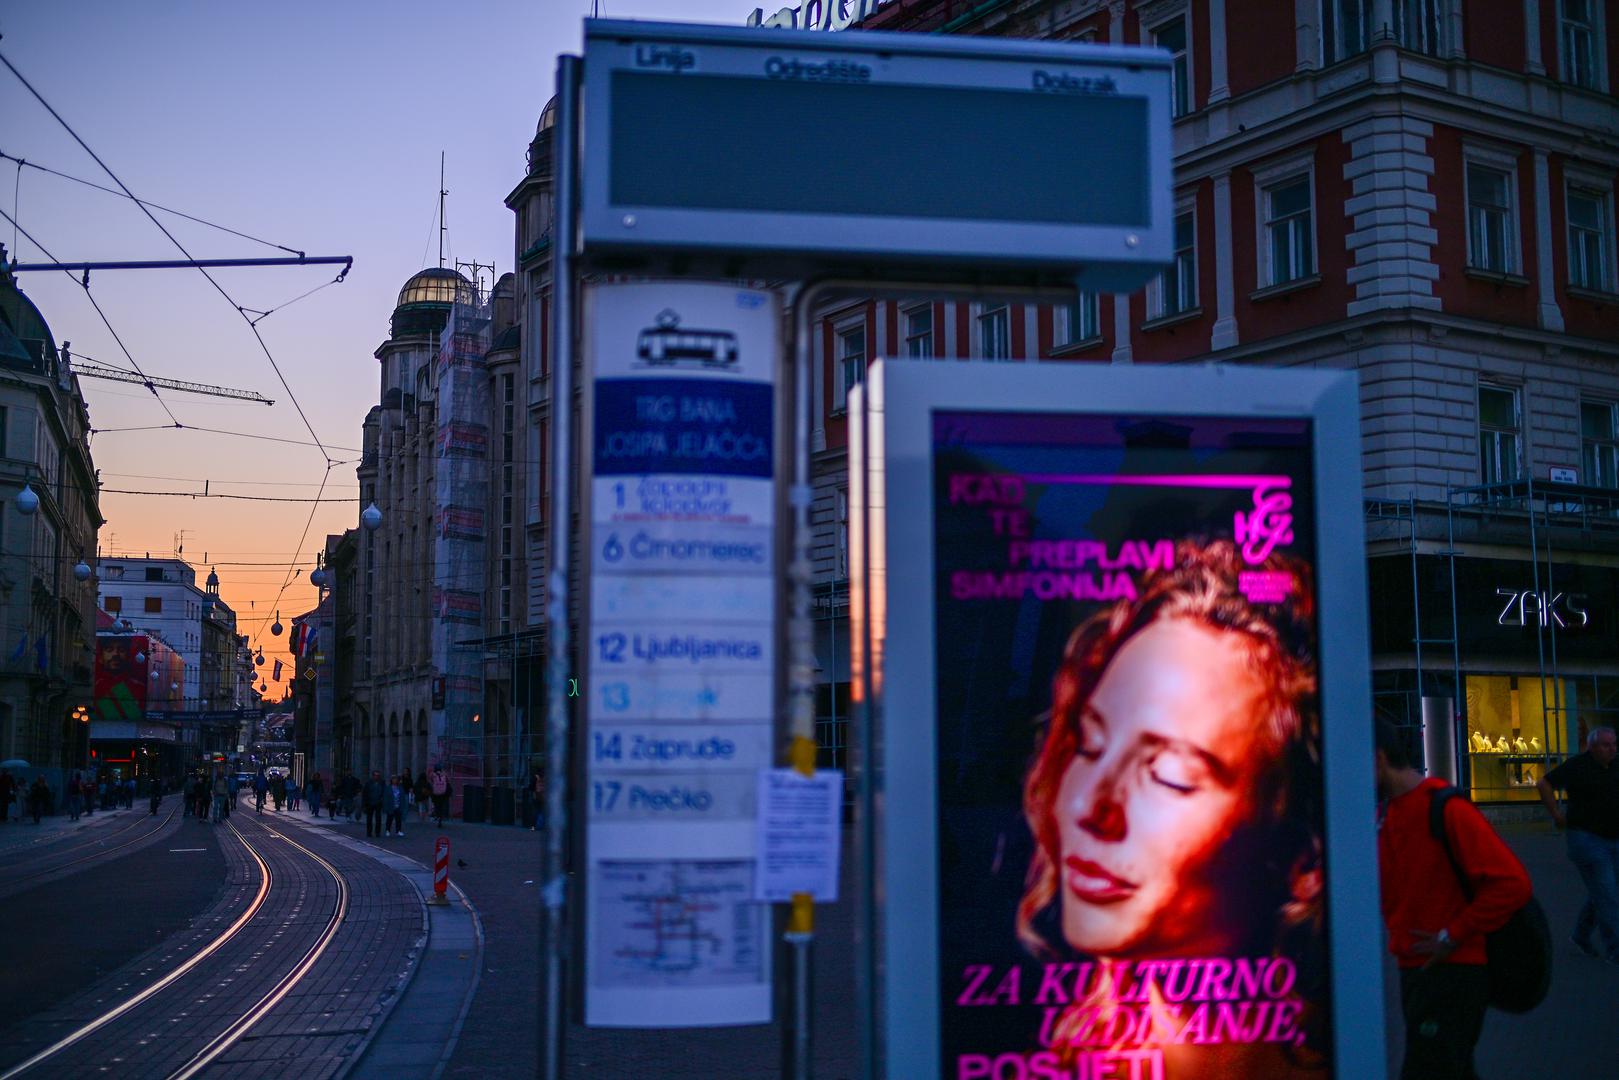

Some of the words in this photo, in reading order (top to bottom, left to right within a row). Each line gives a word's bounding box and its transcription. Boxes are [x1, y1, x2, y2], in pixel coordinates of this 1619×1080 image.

[635, 45, 695, 75] Linija
[764, 55, 872, 83] Odredište
[1033, 69, 1117, 97] Dolazak
[636, 395, 677, 422] TRG
[681, 396, 738, 423] BANA
[612, 482, 625, 509] 1
[948, 475, 1024, 506] KAD
[987, 509, 1028, 537] TE
[602, 533, 625, 563] 6
[1007, 539, 1175, 570] PREPLAVI
[950, 569, 1138, 602] SIMFONIJA
[597, 632, 627, 663] 12
[632, 634, 763, 664] Ljubljanica
[600, 681, 631, 713] 13
[594, 731, 622, 762] 14
[594, 780, 622, 813] 17
[628, 785, 712, 812] Prečko
[956, 963, 1021, 1005] ZA
[1033, 956, 1297, 1004] KULTURNO
